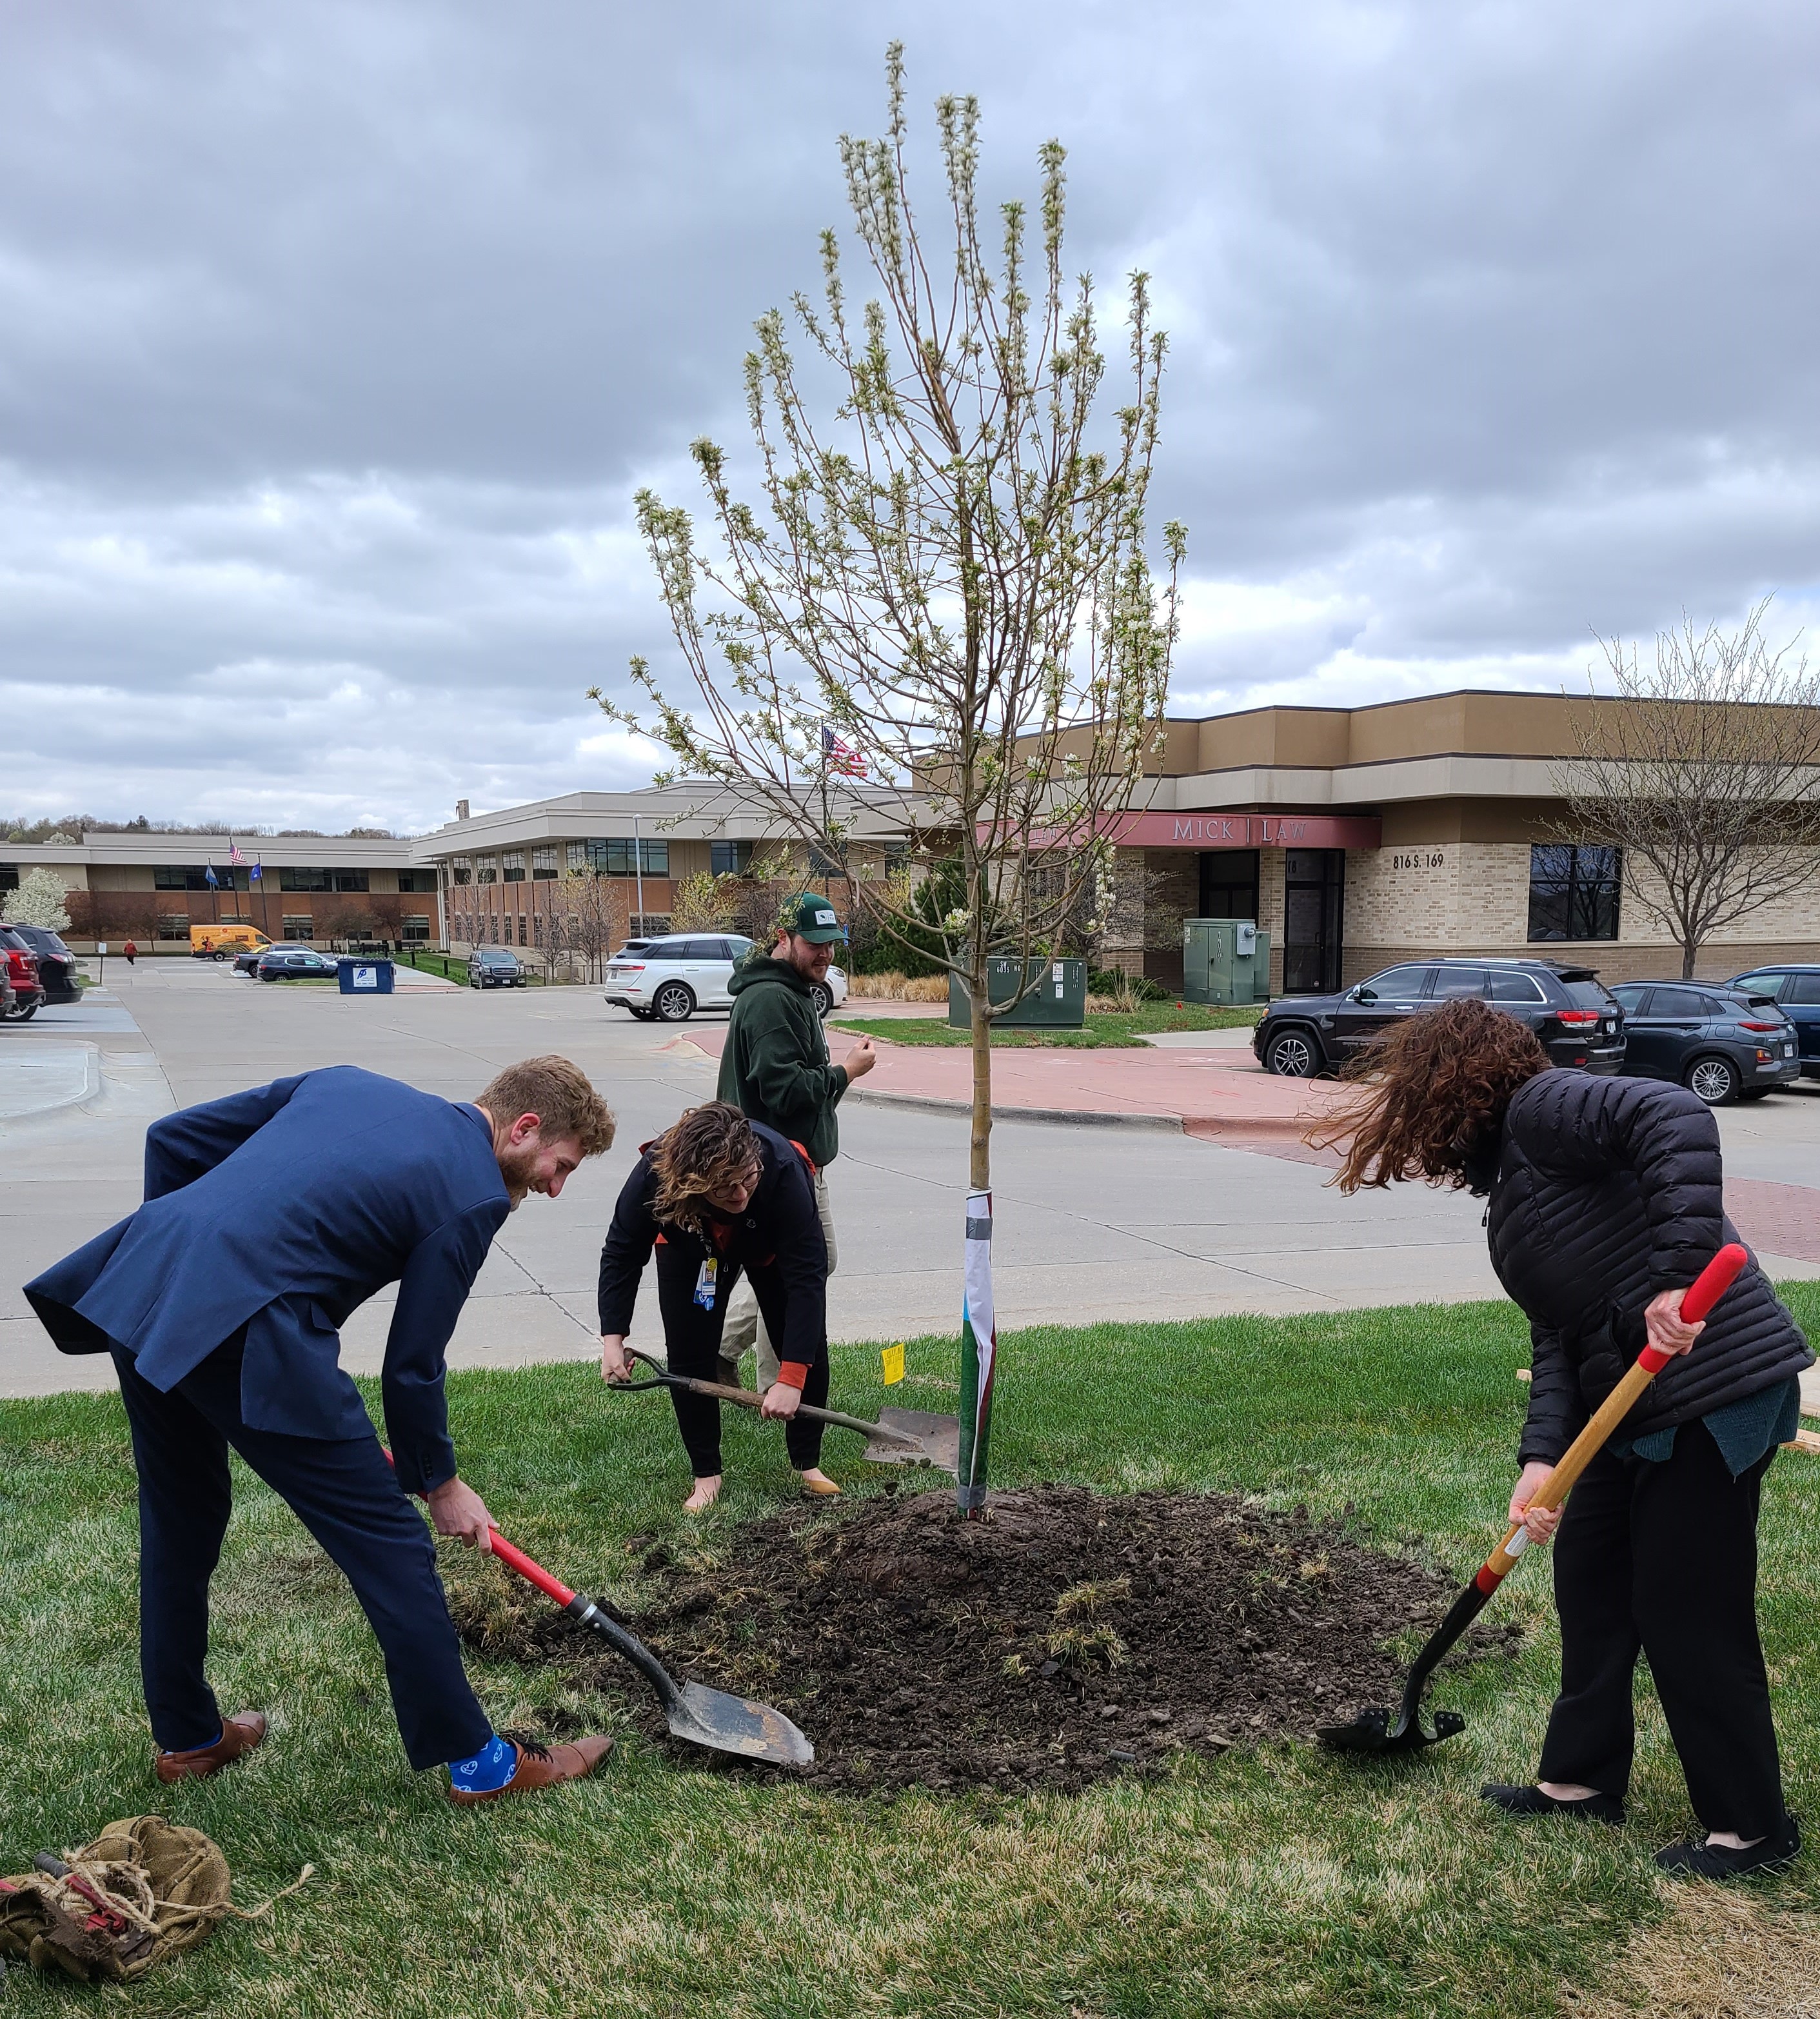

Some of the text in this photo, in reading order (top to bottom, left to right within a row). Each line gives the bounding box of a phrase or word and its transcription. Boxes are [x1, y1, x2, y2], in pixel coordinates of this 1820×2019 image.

[1172, 818, 1307, 842] MICK LAW
[1393, 853, 1444, 869] 816 S. 169
